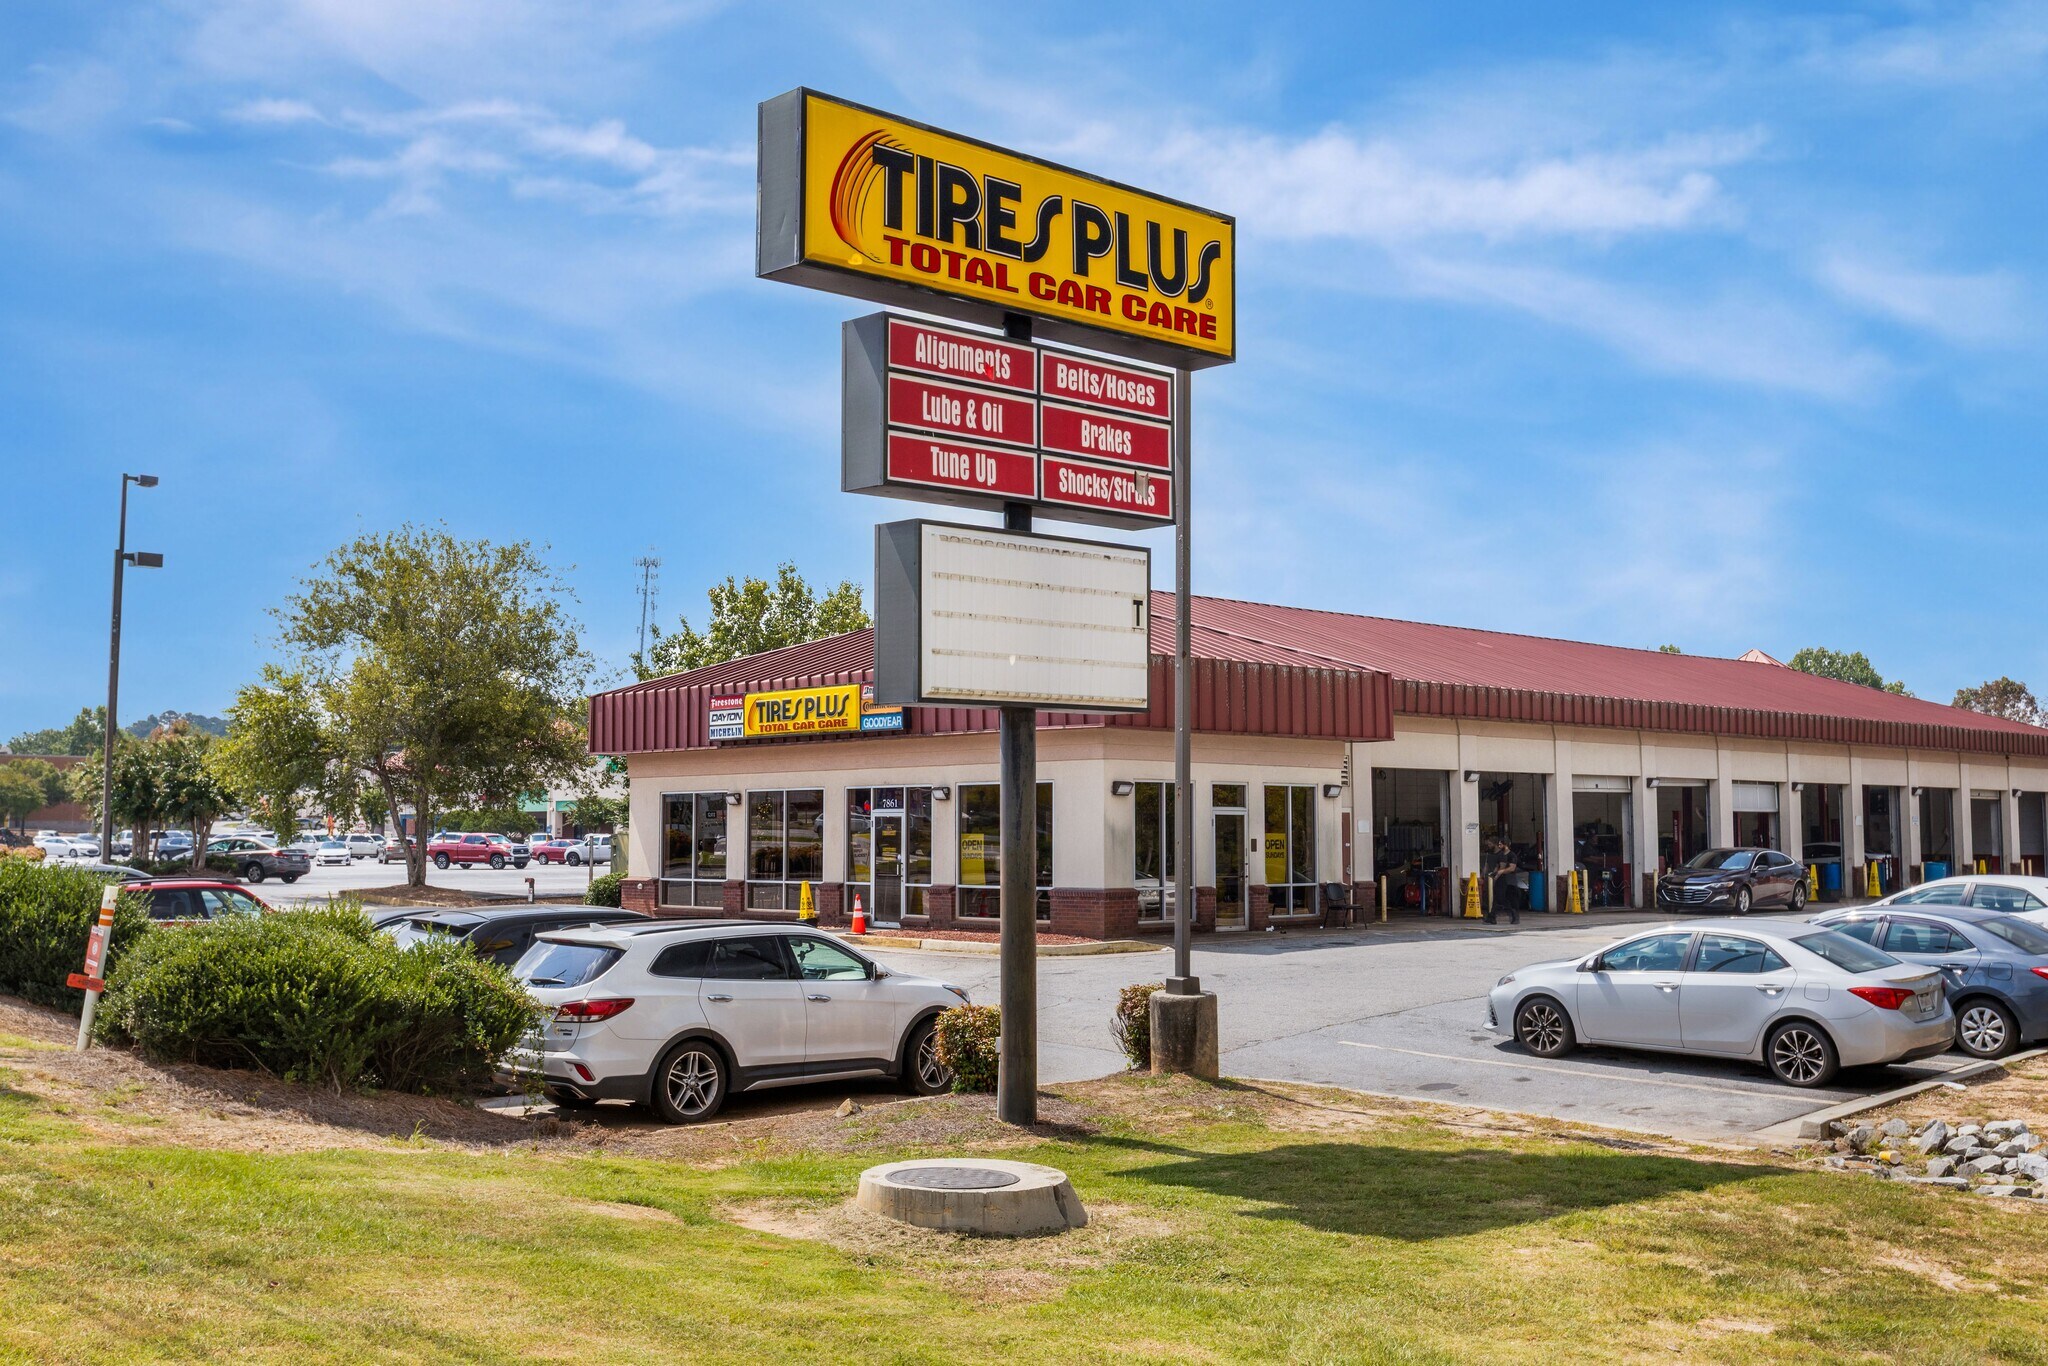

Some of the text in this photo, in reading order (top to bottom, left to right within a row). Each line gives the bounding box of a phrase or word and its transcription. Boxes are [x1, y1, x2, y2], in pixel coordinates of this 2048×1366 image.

[872, 143, 1221, 304] TIRES PLUS
[883, 234, 1217, 341] TOTAL CAR CARE
[915, 332, 1011, 380] Alignments
[1056, 363, 1156, 408] Belts/Hoses
[922, 390, 1004, 434] Lube & Oil
[1081, 419, 1132, 456] Brakes
[930, 446, 997, 487] Tune Up
[1058, 467, 1156, 507] Shocks/Strus
[1132, 600, 1143, 627] T
[711, 698, 743, 709] Firestone
[711, 711, 743, 723] DAYTON
[756, 698, 803, 724] TIRES
[804, 693, 850, 720] PLUS
[710, 727, 743, 738] MICHELIN
[759, 718, 848, 733] TOTAL CAR CARE
[863, 715, 903, 729] GOODYEAR
[962, 839, 983, 850] OPEN
[1265, 839, 1285, 849] OPEN
